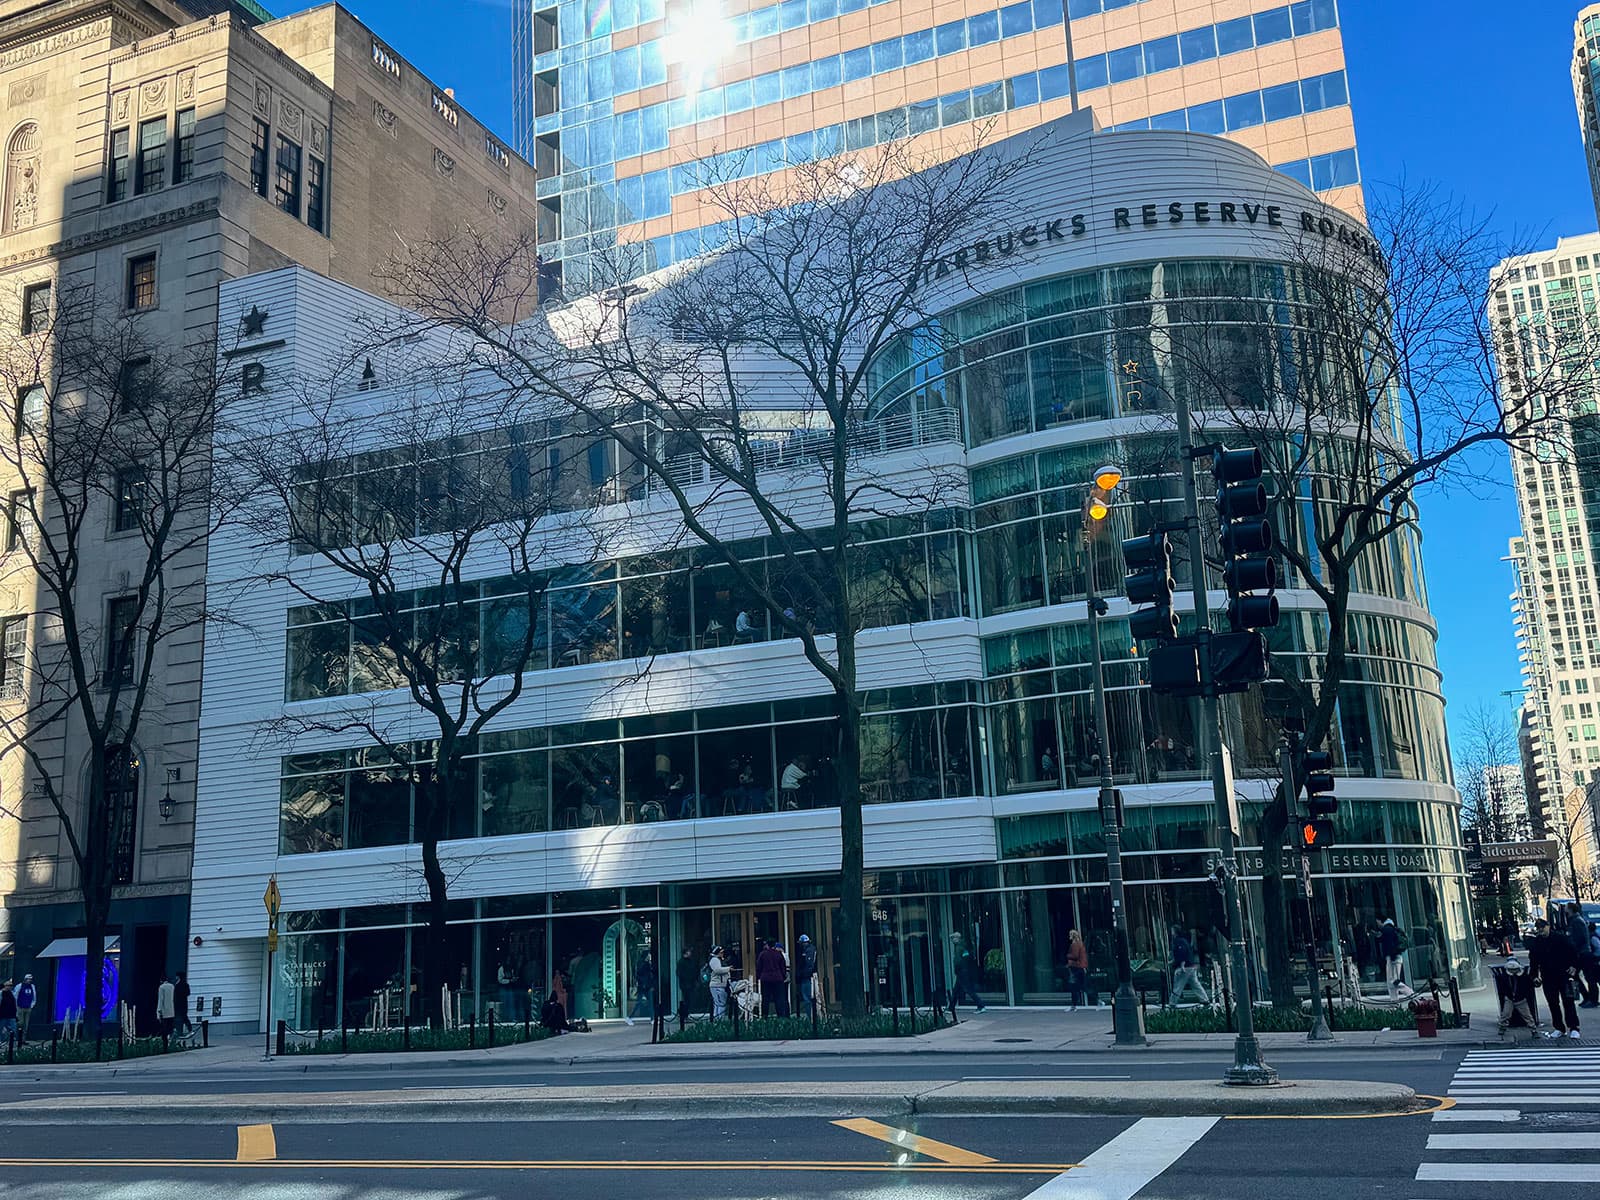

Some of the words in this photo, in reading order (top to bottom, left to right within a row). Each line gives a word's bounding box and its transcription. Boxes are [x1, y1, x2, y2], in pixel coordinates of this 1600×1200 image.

[909, 213, 1087, 293] TARBUCKS
[1114, 201, 1283, 228] RESERVE
[242, 362, 265, 394] R
[1480, 846, 1529, 858] sidence
[1331, 855, 1387, 867] ESERVE
[872, 910, 888, 921] 646
[289, 980, 322, 989] OASTERY
